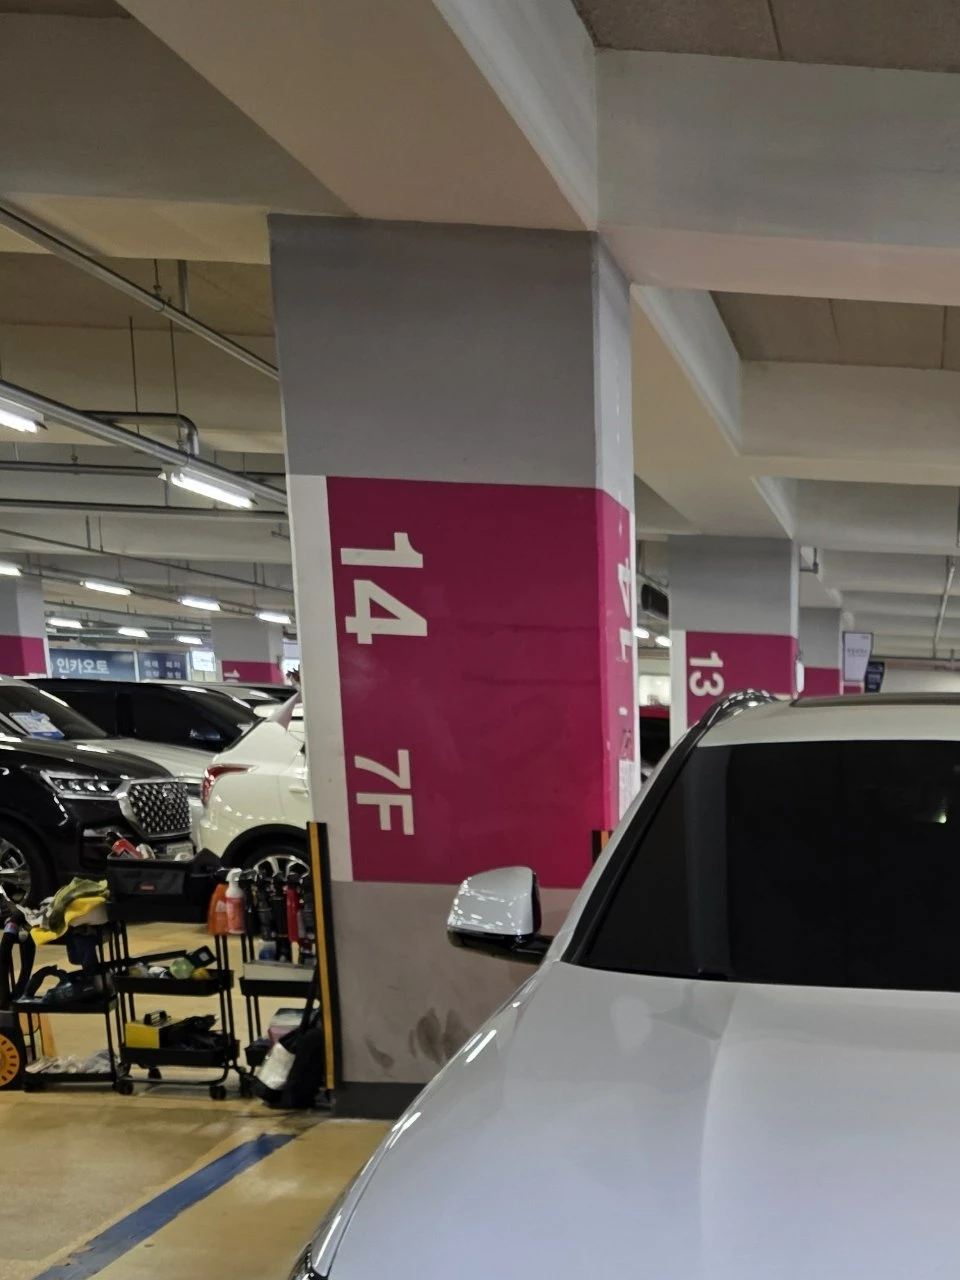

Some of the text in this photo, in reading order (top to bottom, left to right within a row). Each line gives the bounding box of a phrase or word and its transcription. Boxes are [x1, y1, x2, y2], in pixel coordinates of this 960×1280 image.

[341, 532, 427, 644] 14
[56, 657, 110, 675] 인카오토
[689, 651, 725, 697] 13
[354, 749, 415, 836] 7F
